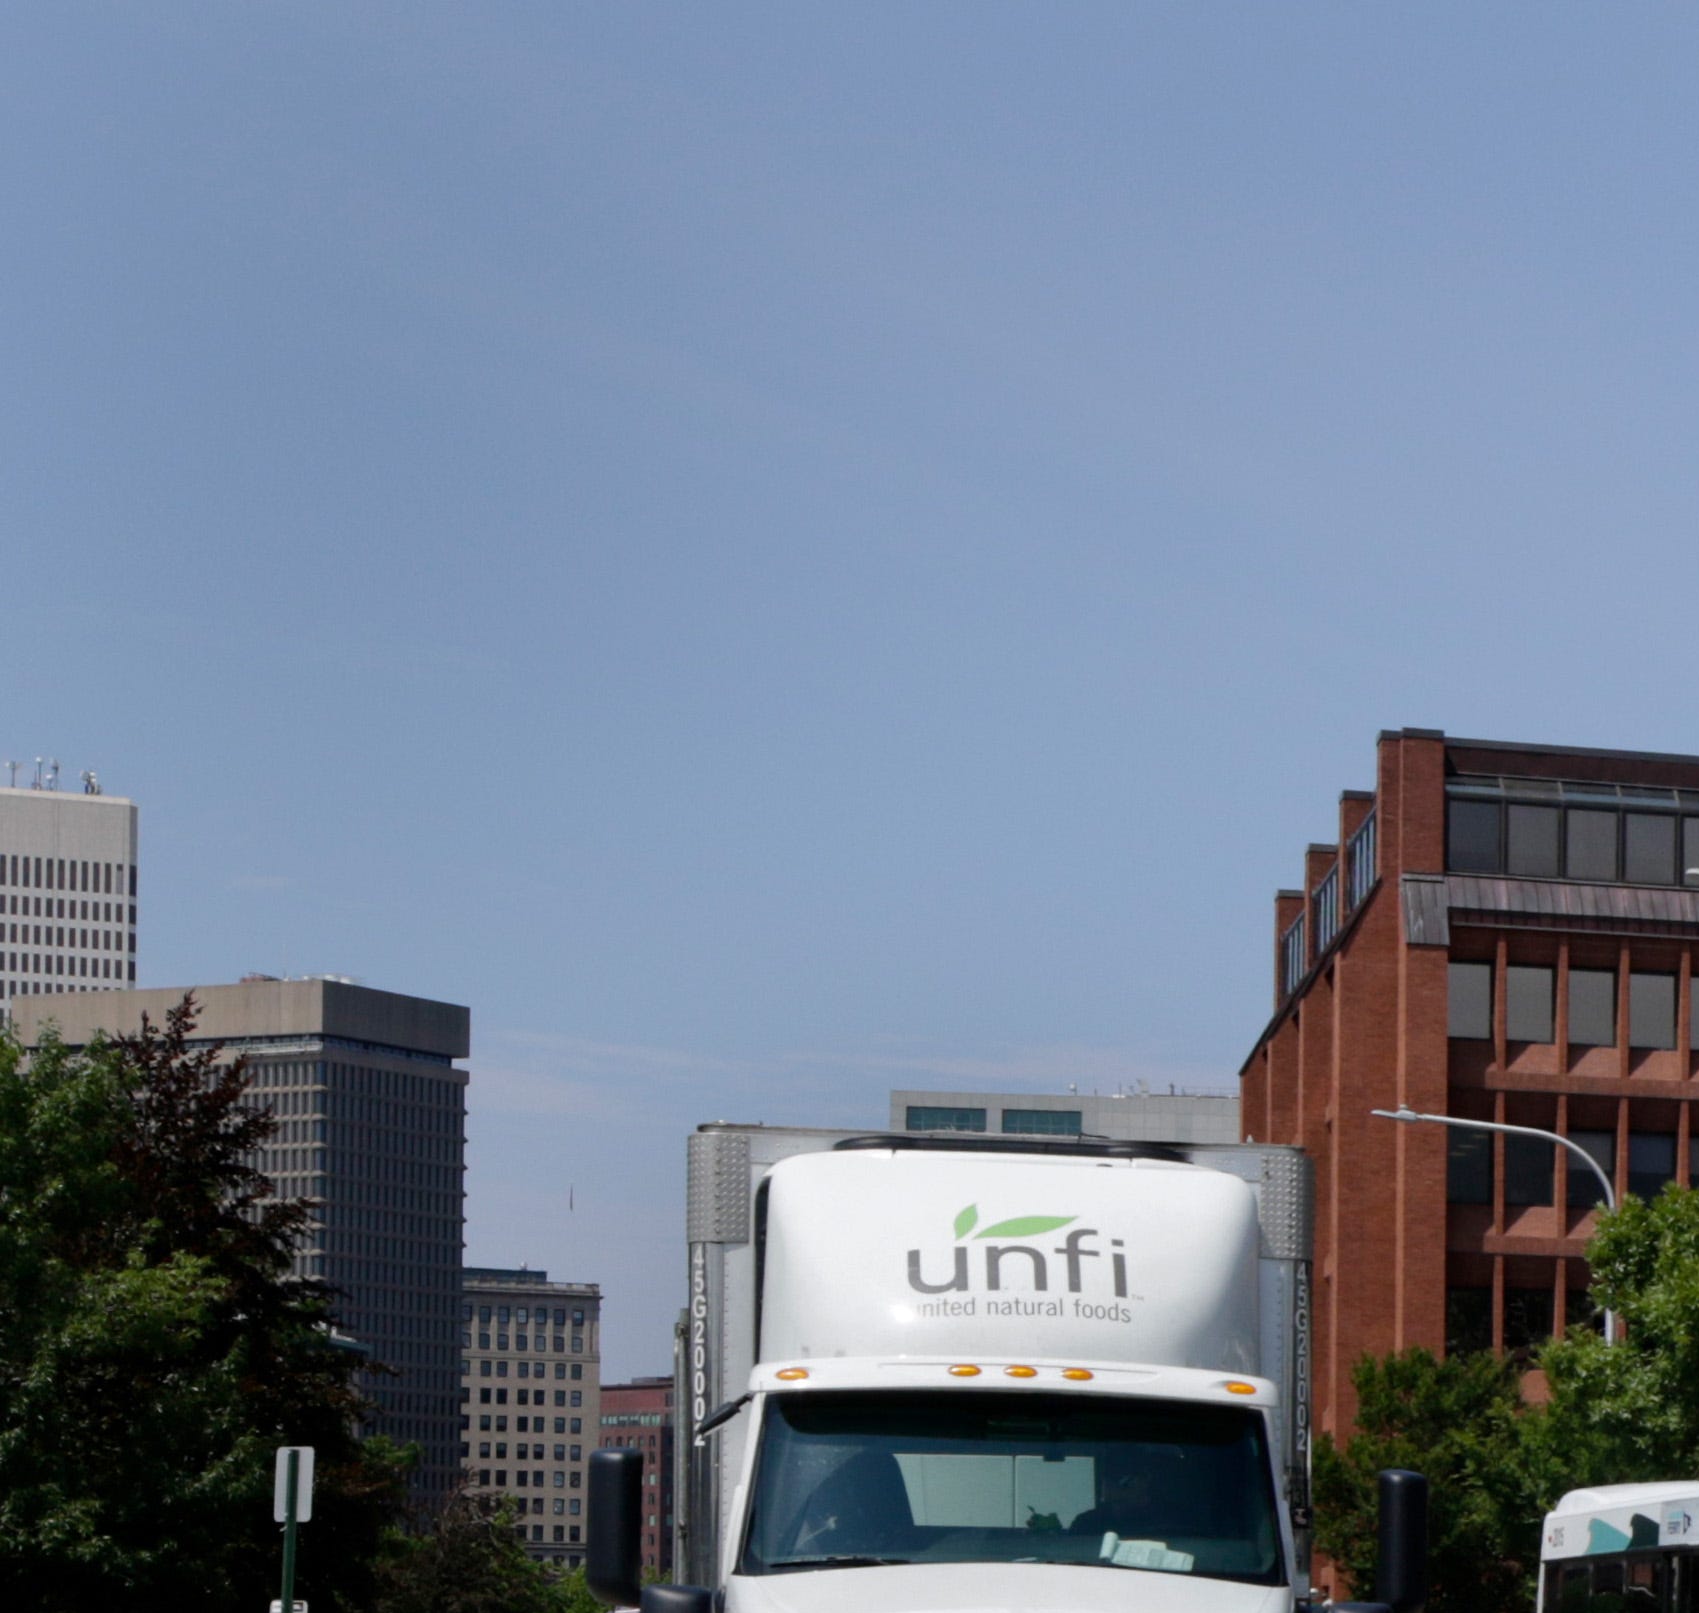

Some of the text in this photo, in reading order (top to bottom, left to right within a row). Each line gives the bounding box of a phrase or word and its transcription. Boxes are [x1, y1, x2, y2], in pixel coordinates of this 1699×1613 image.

[907, 1228, 1128, 1299] unfi
[986, 1298, 1064, 1317] natural
[1074, 1300, 1132, 1324] foods
